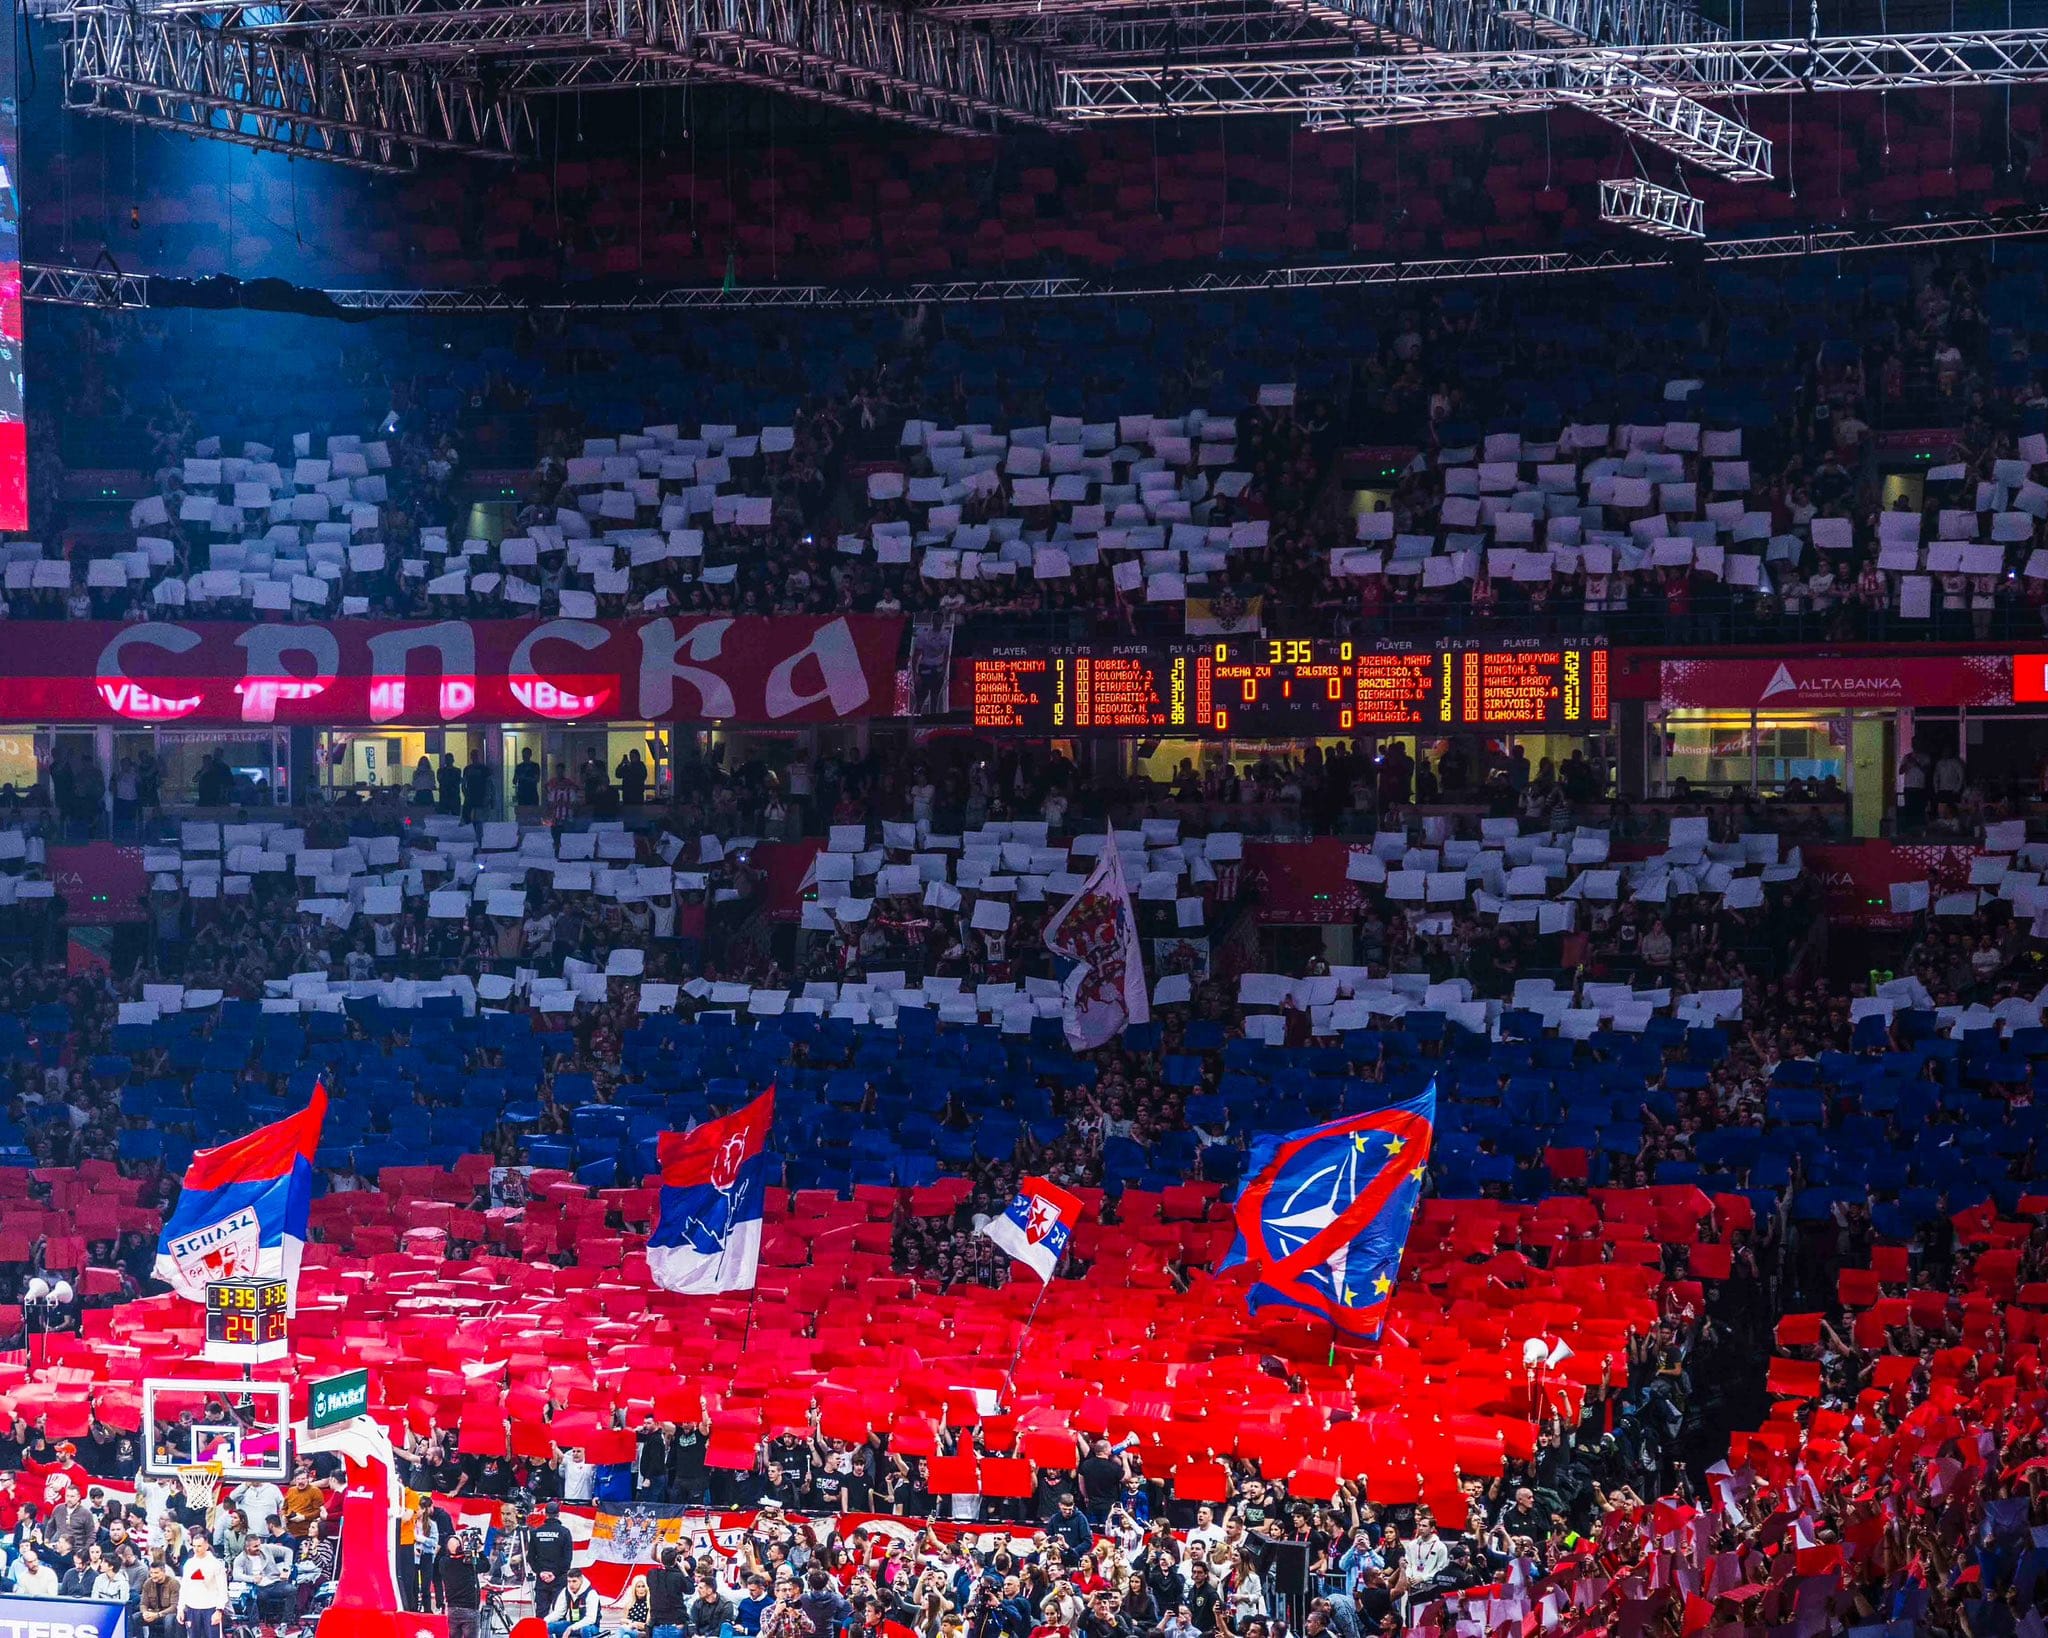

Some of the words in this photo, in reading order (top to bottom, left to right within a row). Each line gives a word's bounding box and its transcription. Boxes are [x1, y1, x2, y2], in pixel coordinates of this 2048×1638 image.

[1113, 646, 1148, 654] PLAYER
[1376, 641, 1412, 650] PLAYER
[1503, 639, 1540, 647] PLAYER
[993, 647, 1027, 656] PLAYER
[1216, 644, 1226, 662] 0
[1341, 642, 1352, 661] 0
[1216, 666, 1251, 677] CRVENA
[1296, 666, 1338, 677] ZALGIRIS
[1244, 678, 1256, 700] 0
[1329, 677, 1341, 699] 0
[1799, 678, 1902, 689] ALTABANKA
[1216, 711, 1227, 729] 0
[1341, 710, 1352, 728] 0
[226, 1316, 256, 1342] 24
[268, 1315, 287, 1339] 24
